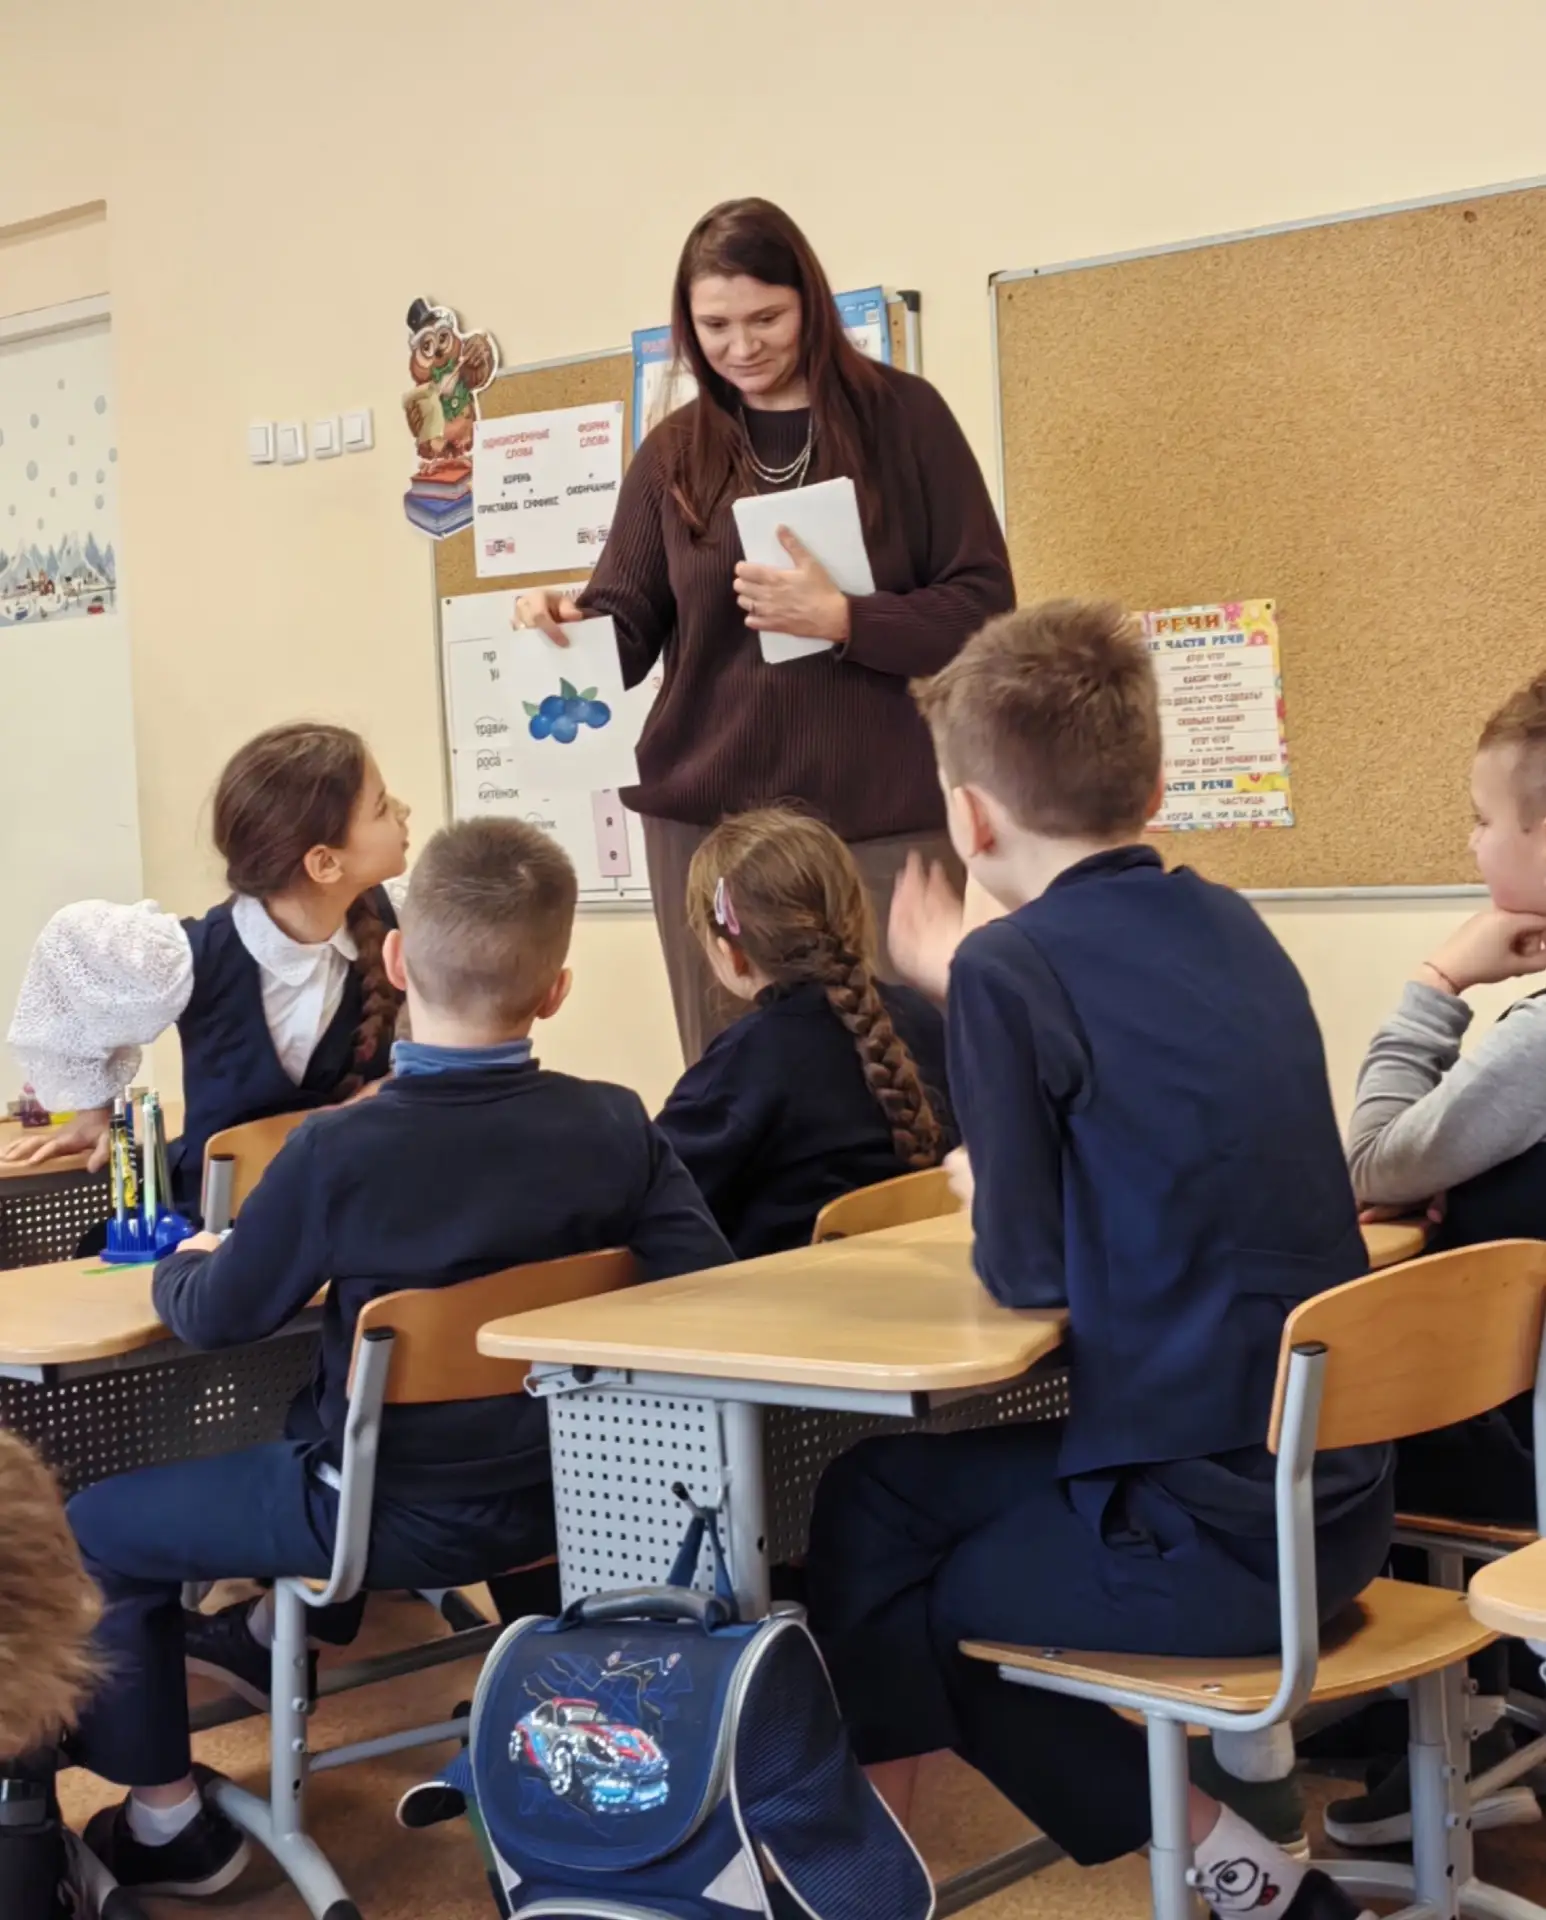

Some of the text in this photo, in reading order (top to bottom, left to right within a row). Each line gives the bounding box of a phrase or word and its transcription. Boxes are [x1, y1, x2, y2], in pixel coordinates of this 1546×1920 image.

[580, 435, 610, 448] СЛОВА
[505, 446, 533, 459] СЛОВА
[503, 472, 531, 485] КОРЕНЬ
[565, 480, 616, 496] ОКОНЧАНИЕ
[477, 496, 560, 514] ПРИСТАВКА СУФФИКС
[1155, 613, 1219, 636] РЕЧИ
[1165, 637, 1206, 649] ЧАСТИ
[1212, 632, 1245, 646] РЕЧИ
[482, 650, 497, 664] пр
[1165, 779, 1234, 792] АСТИ РЕЧИ
